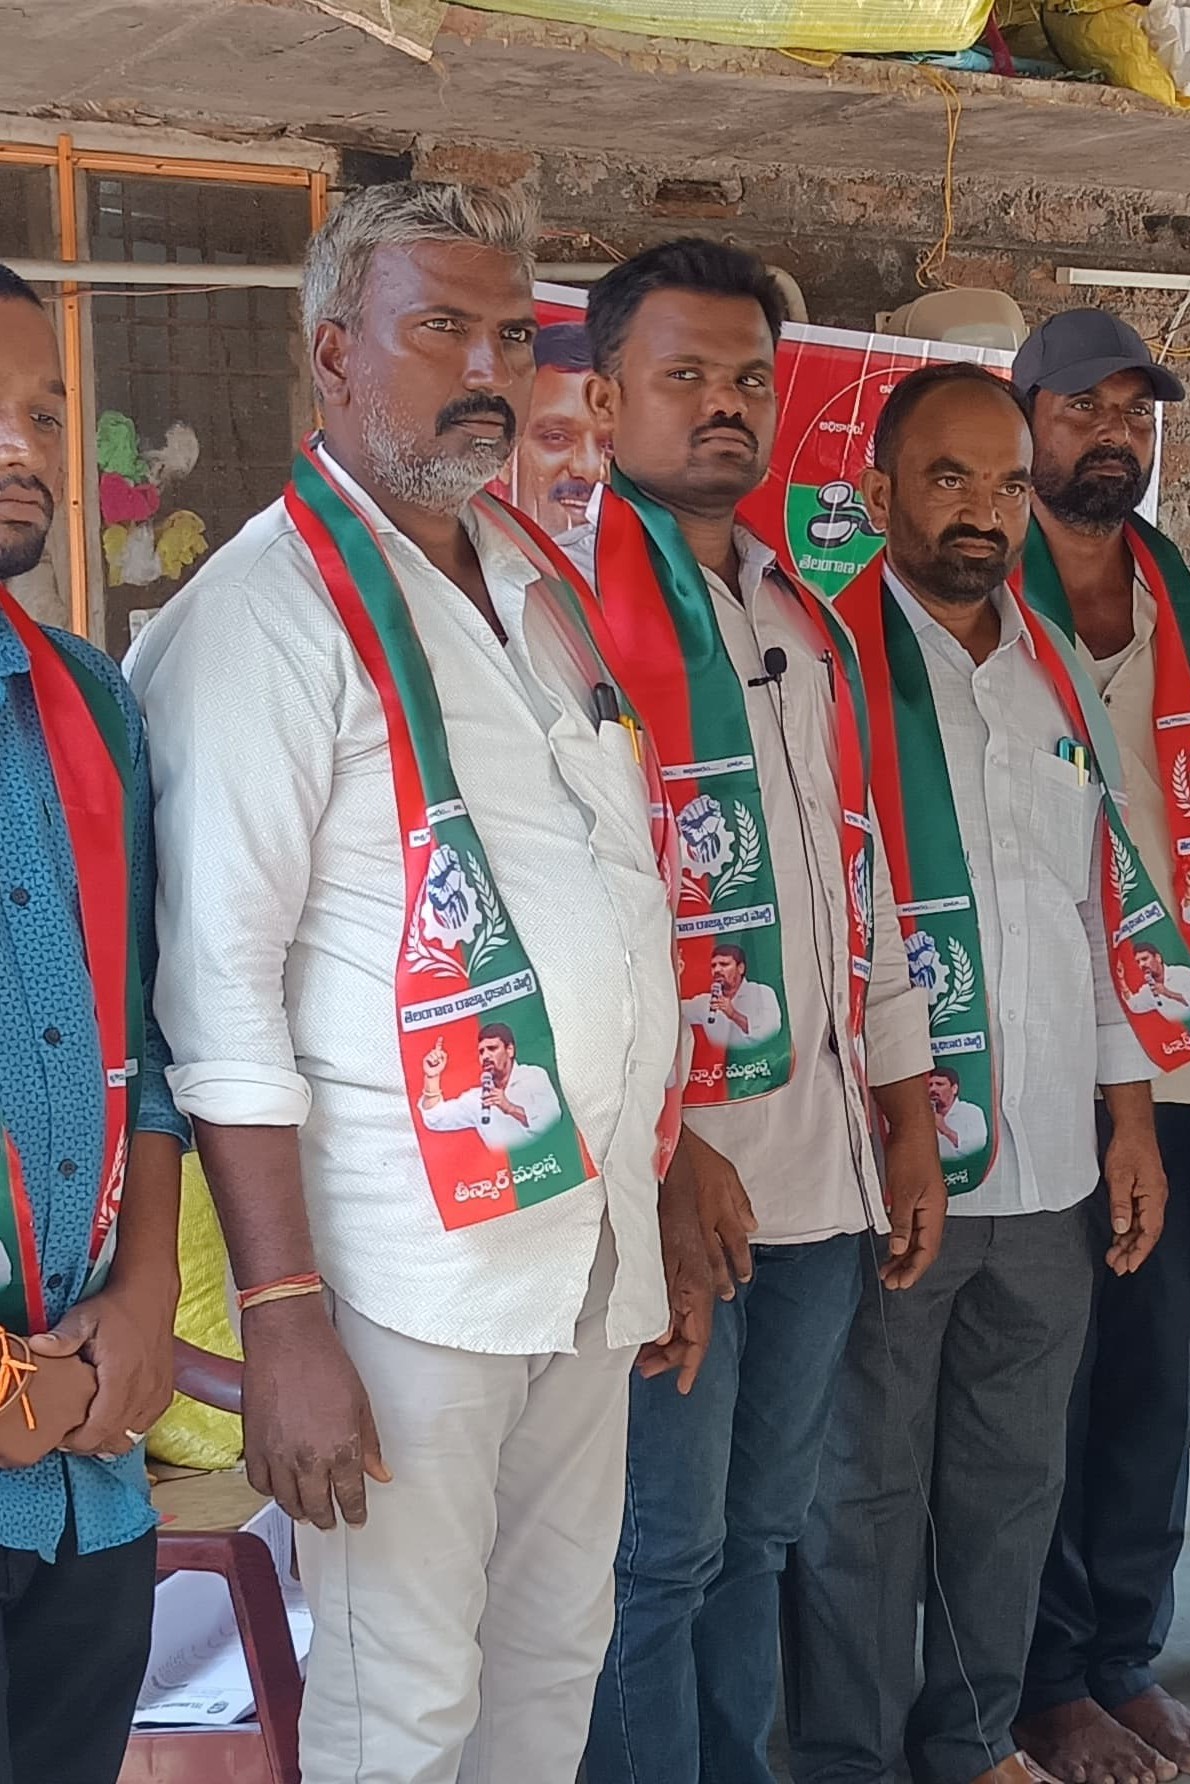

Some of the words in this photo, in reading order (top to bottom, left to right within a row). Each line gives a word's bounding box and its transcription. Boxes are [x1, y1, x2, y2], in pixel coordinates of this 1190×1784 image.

[799, 554, 856, 574] తెలంగాణ
[404, 1003, 454, 1024] తెలంగాణ
[455, 981, 513, 1008] రాజ్యాధికార
[513, 972, 533, 993] పార్టీ
[689, 1063, 723, 1087] న్మార్
[725, 1059, 772, 1081] మల్లన్న
[454, 1168, 511, 1202] తీన్మార్
[511, 1153, 562, 1184] మల్లన్న
